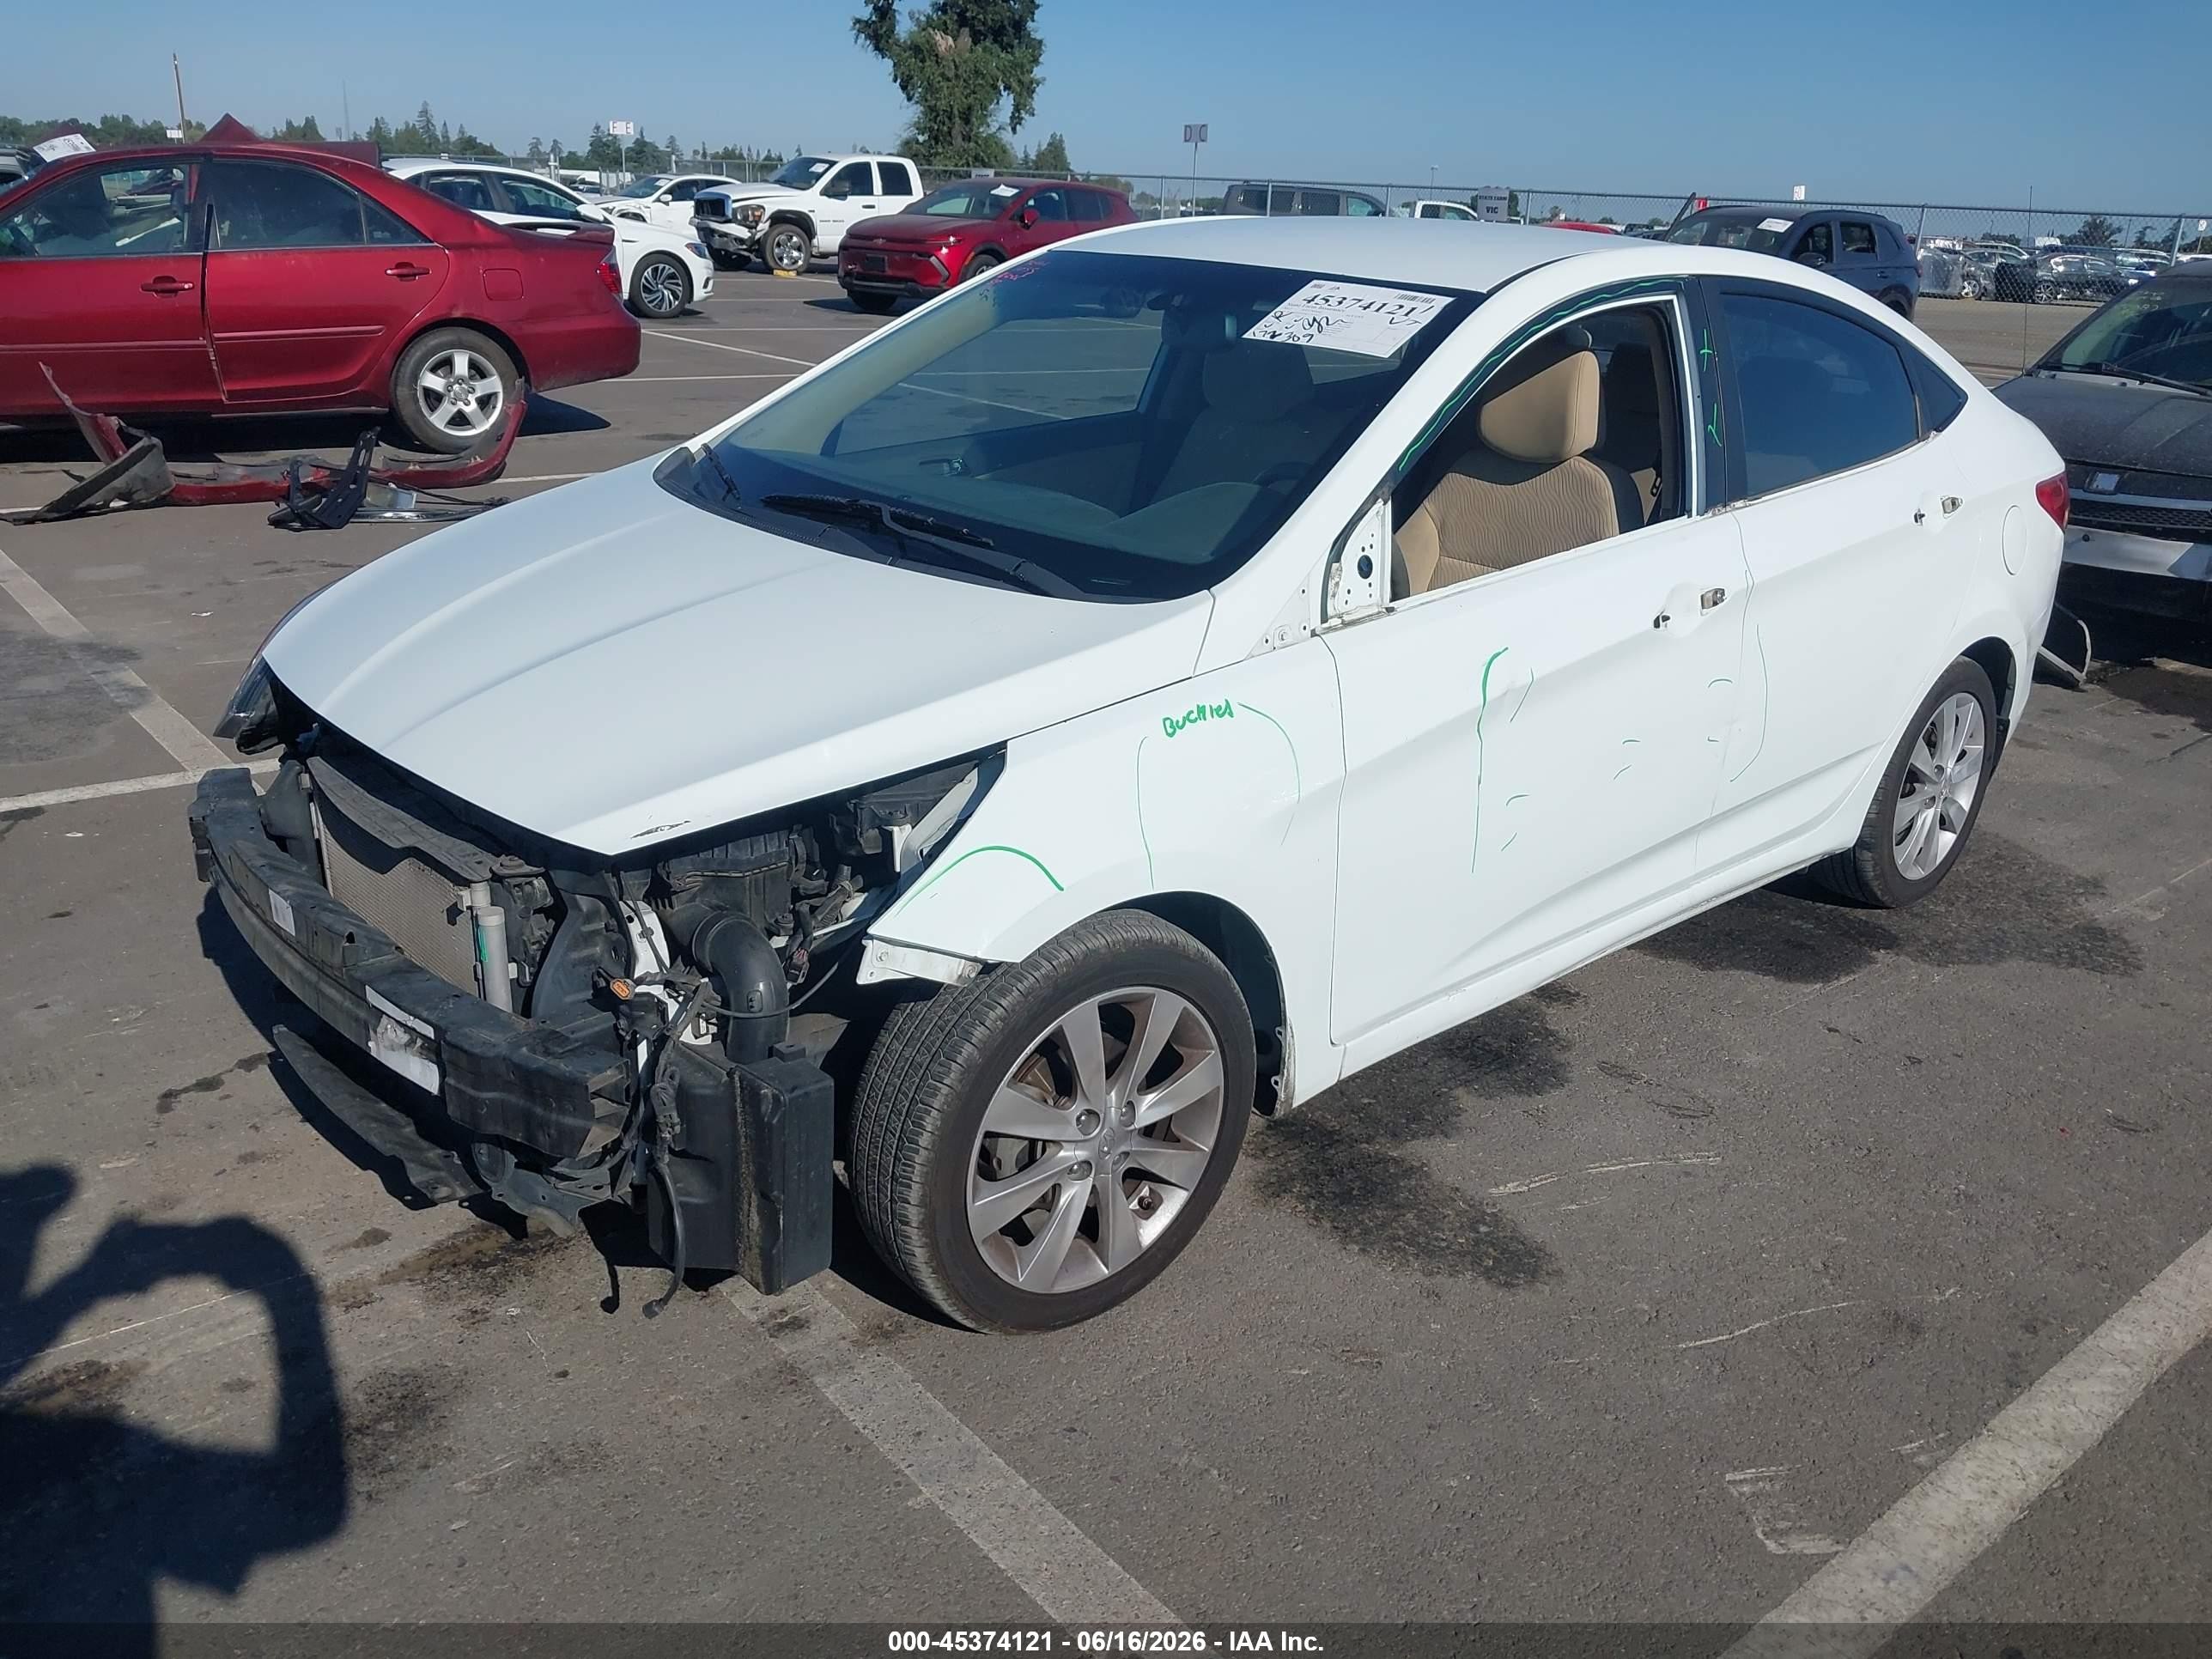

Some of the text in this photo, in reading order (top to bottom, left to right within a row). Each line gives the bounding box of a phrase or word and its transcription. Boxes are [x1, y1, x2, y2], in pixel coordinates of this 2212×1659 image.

[1184, 125, 1206, 142] D C
[1303, 294, 1419, 317] 45374121
